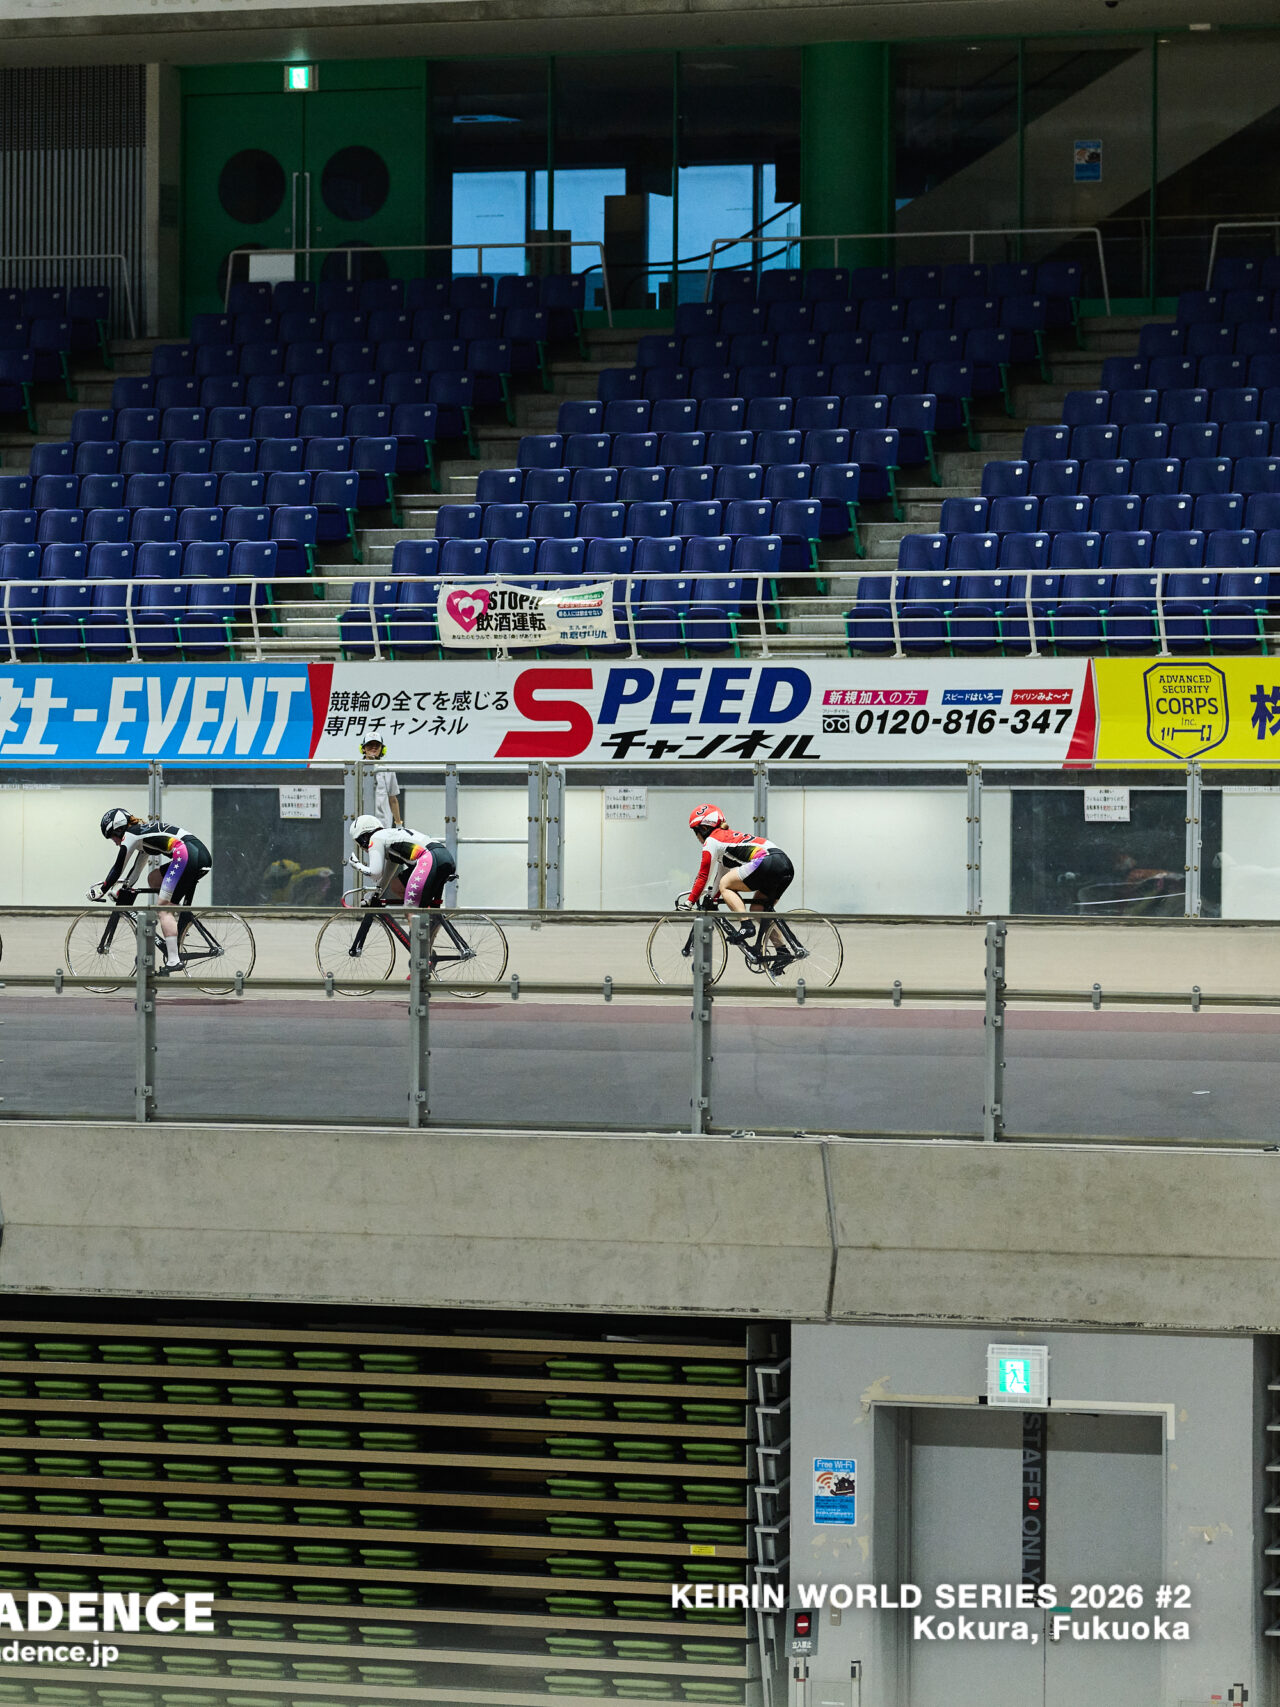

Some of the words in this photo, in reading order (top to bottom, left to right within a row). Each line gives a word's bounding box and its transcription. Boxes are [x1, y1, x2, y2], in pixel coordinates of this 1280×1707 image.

[476, 612, 547, 632] 飲酒運転
[1159, 675, 1212, 684] ADVANCED
[1162, 685, 1210, 694] SECURITY
[329, 690, 510, 712] 競輪の全てを感じる
[828, 690, 919, 705] 新規加入の方
[944, 692, 1003, 702] スピードはいろー
[1155, 697, 1219, 715] CORPS
[493, 667, 812, 758] SPEED
[855, 709, 1073, 735] 0120-816-347
[1181, 717, 1197, 726] Inc.
[324, 715, 469, 737] 専門チャンネル
[601, 729, 821, 759] チャンネル
[817, 1460, 833, 1469] Free
[835, 1461, 853, 1469] Wi-Fi
[1022, 1413, 1042, 1497] STAFF
[1022, 1515, 1041, 1584] ONLY
